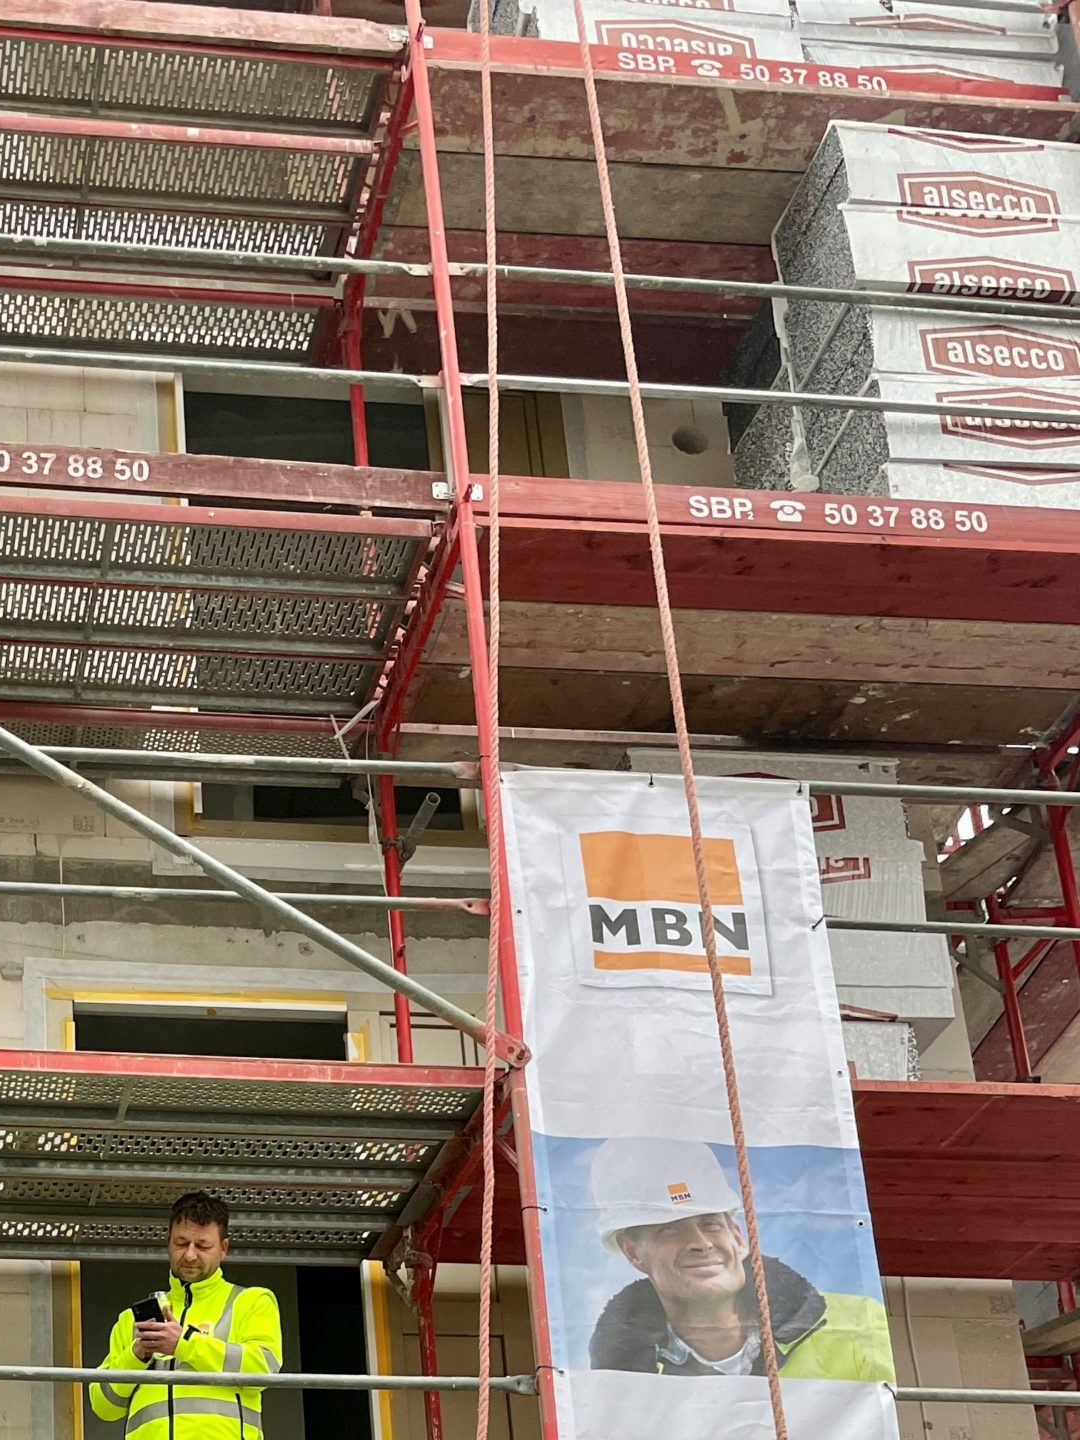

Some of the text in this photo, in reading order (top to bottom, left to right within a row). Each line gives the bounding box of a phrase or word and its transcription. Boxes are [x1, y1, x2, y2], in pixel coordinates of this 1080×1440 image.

[740, 63, 770, 82] 50
[779, 66, 808, 86] 37
[817, 69, 848, 89] 88
[857, 73, 887, 92] 50
[947, 340, 1065, 371] alsecco
[21, 451, 57, 475] 37
[67, 455, 104, 479] 88
[113, 458, 150, 482] 50
[824, 503, 858, 525] 50
[867, 505, 900, 527] 37
[910, 508, 946, 530] 88
[954, 510, 989, 533] 50
[589, 904, 749, 950] MBN
[671, 1192, 691, 1202] MBN
